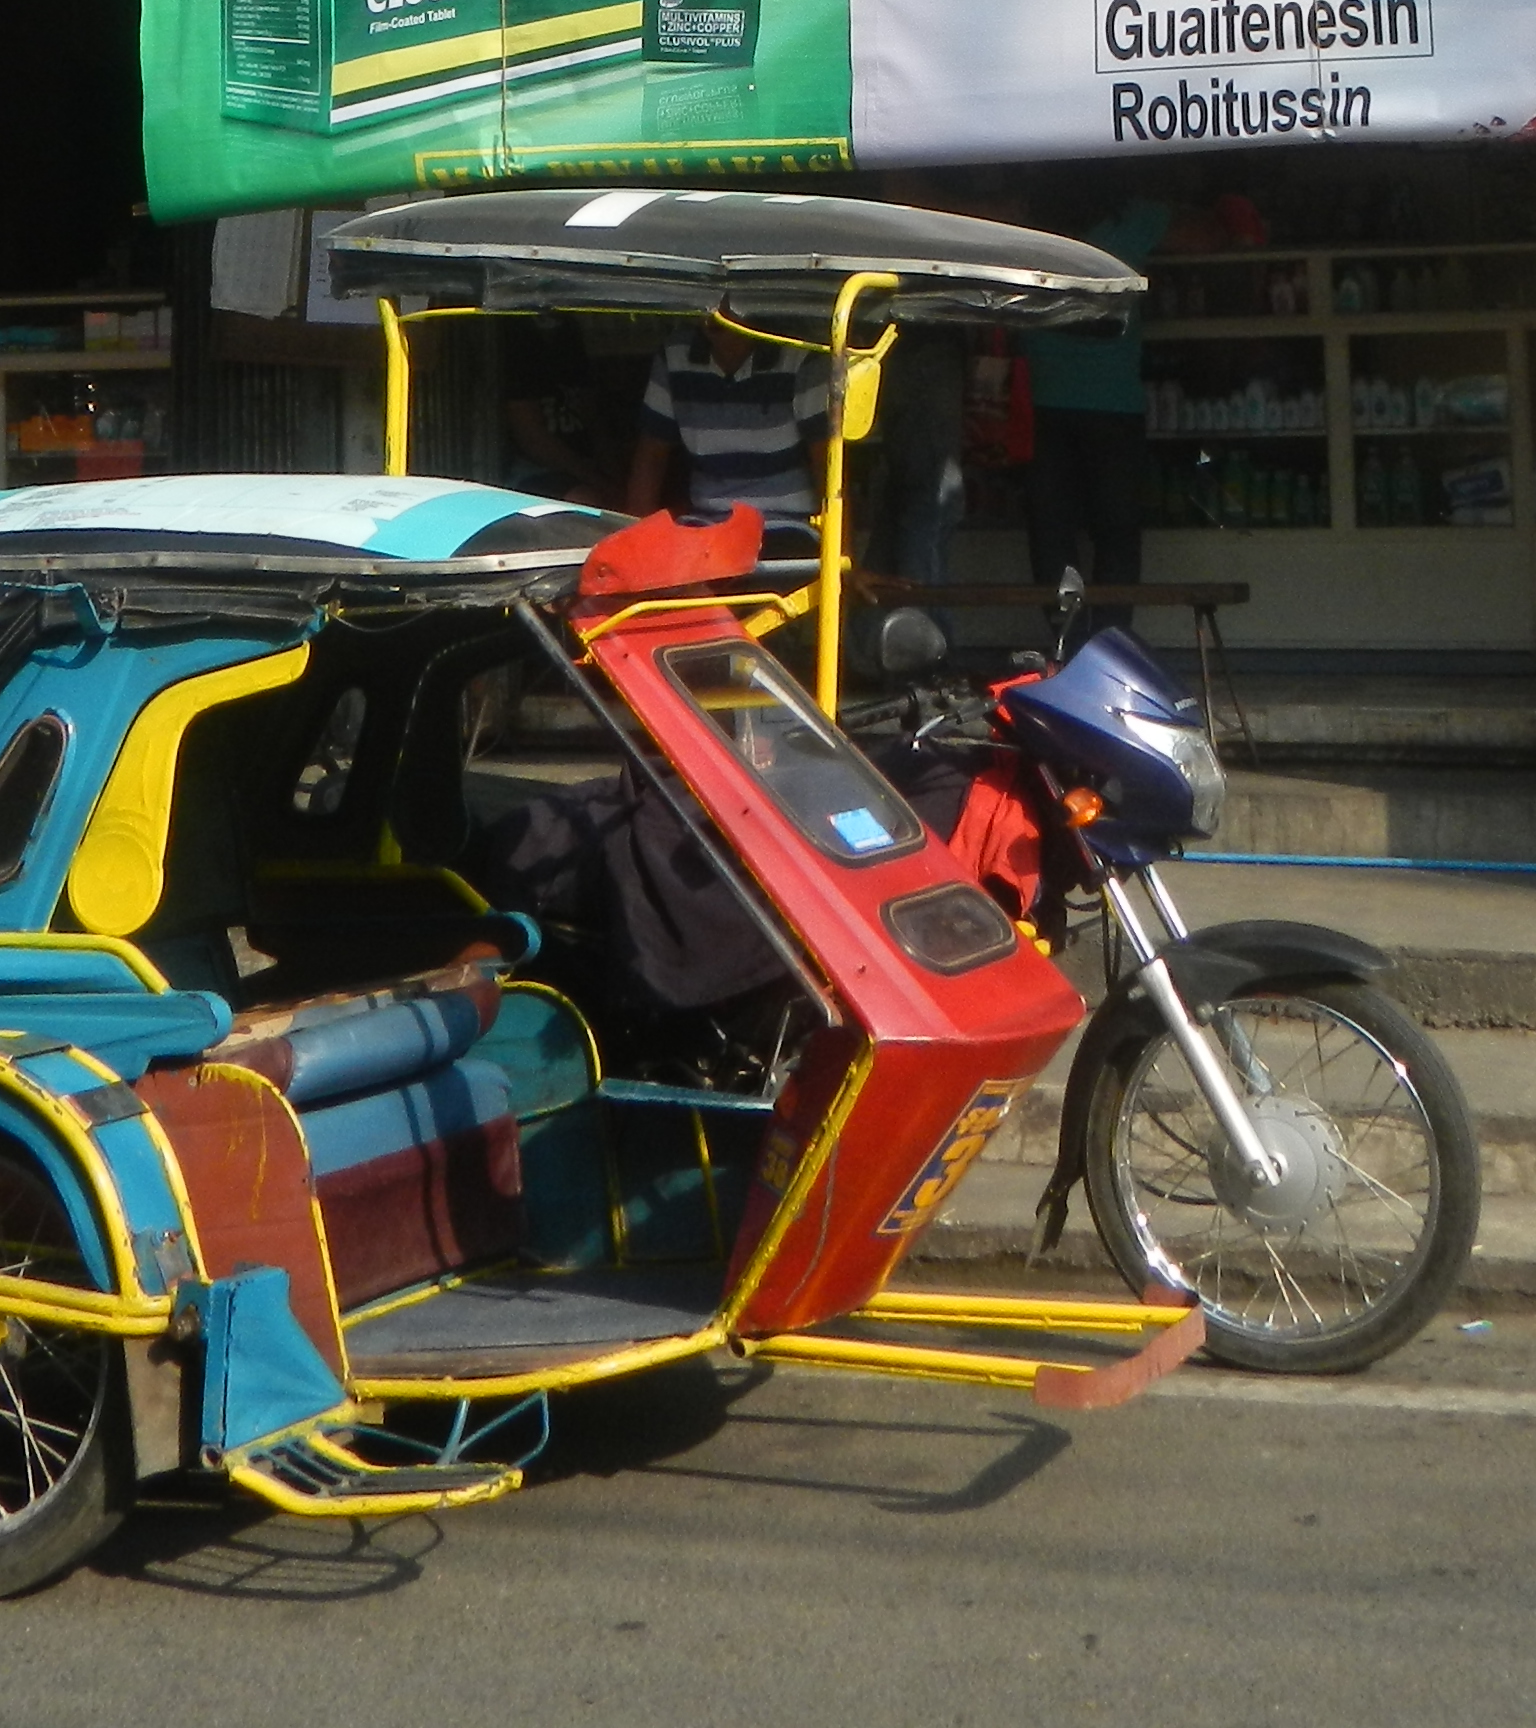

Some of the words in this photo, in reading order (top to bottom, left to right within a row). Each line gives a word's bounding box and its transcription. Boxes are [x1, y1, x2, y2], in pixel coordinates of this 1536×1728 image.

[368, 13, 426, 36] Film-Coated
[426, 7, 457, 24] Tablet
[1112, 71, 1372, 142] Robitussin
